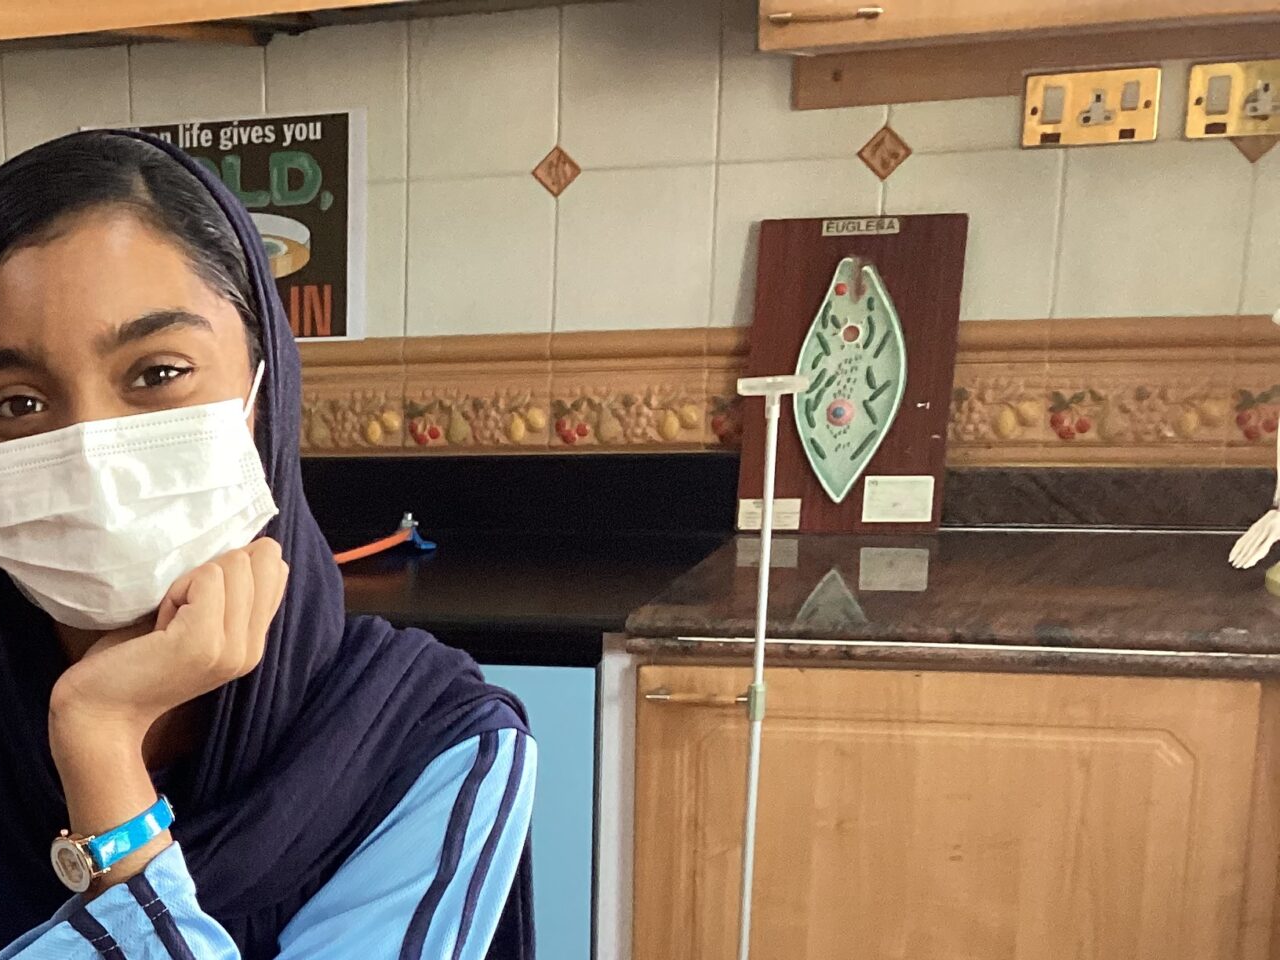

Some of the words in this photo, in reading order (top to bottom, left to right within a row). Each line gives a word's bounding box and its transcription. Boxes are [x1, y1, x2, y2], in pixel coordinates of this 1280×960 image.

[178, 120, 213, 148] life
[219, 121, 276, 150] gives
[282, 121, 323, 147] you
[191, 151, 334, 211] LD,
